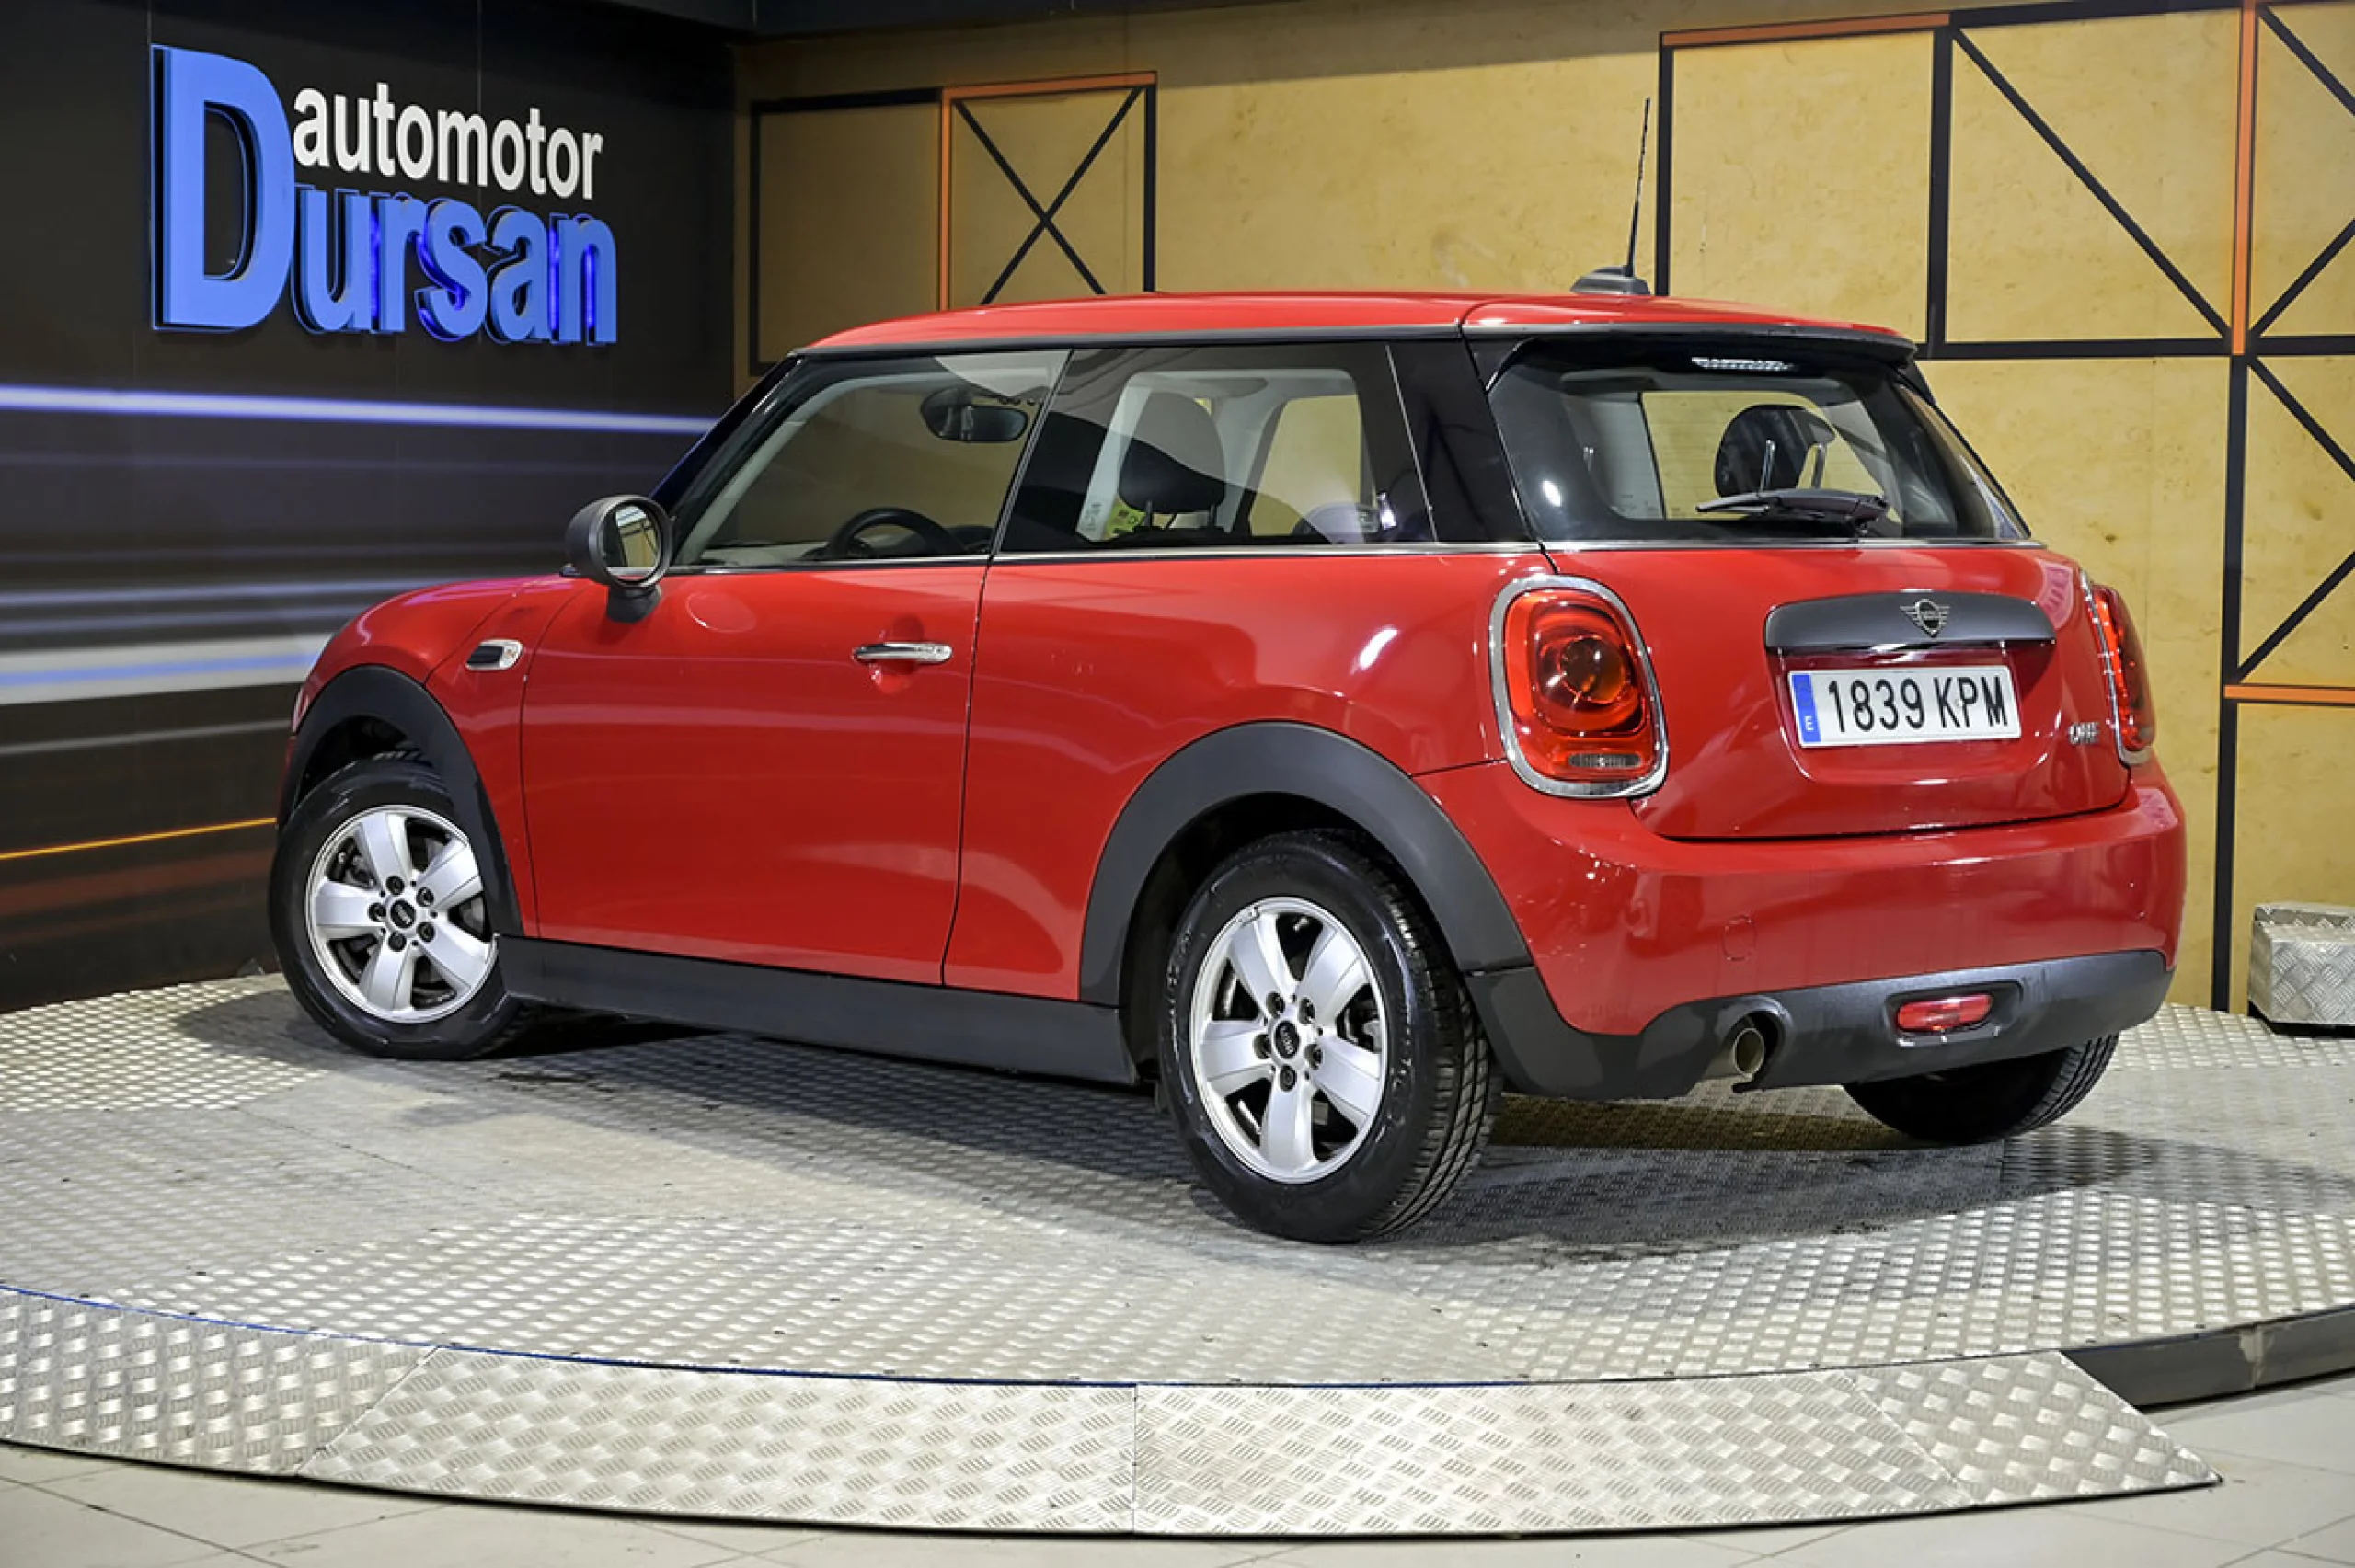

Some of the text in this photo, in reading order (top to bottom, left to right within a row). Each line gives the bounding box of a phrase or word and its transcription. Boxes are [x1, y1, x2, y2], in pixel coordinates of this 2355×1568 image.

[293, 82, 603, 199] automotor
[152, 44, 617, 345] Dursan
[1805, 715, 1814, 731] E
[1828, 675, 2008, 733] 1839 KPM
